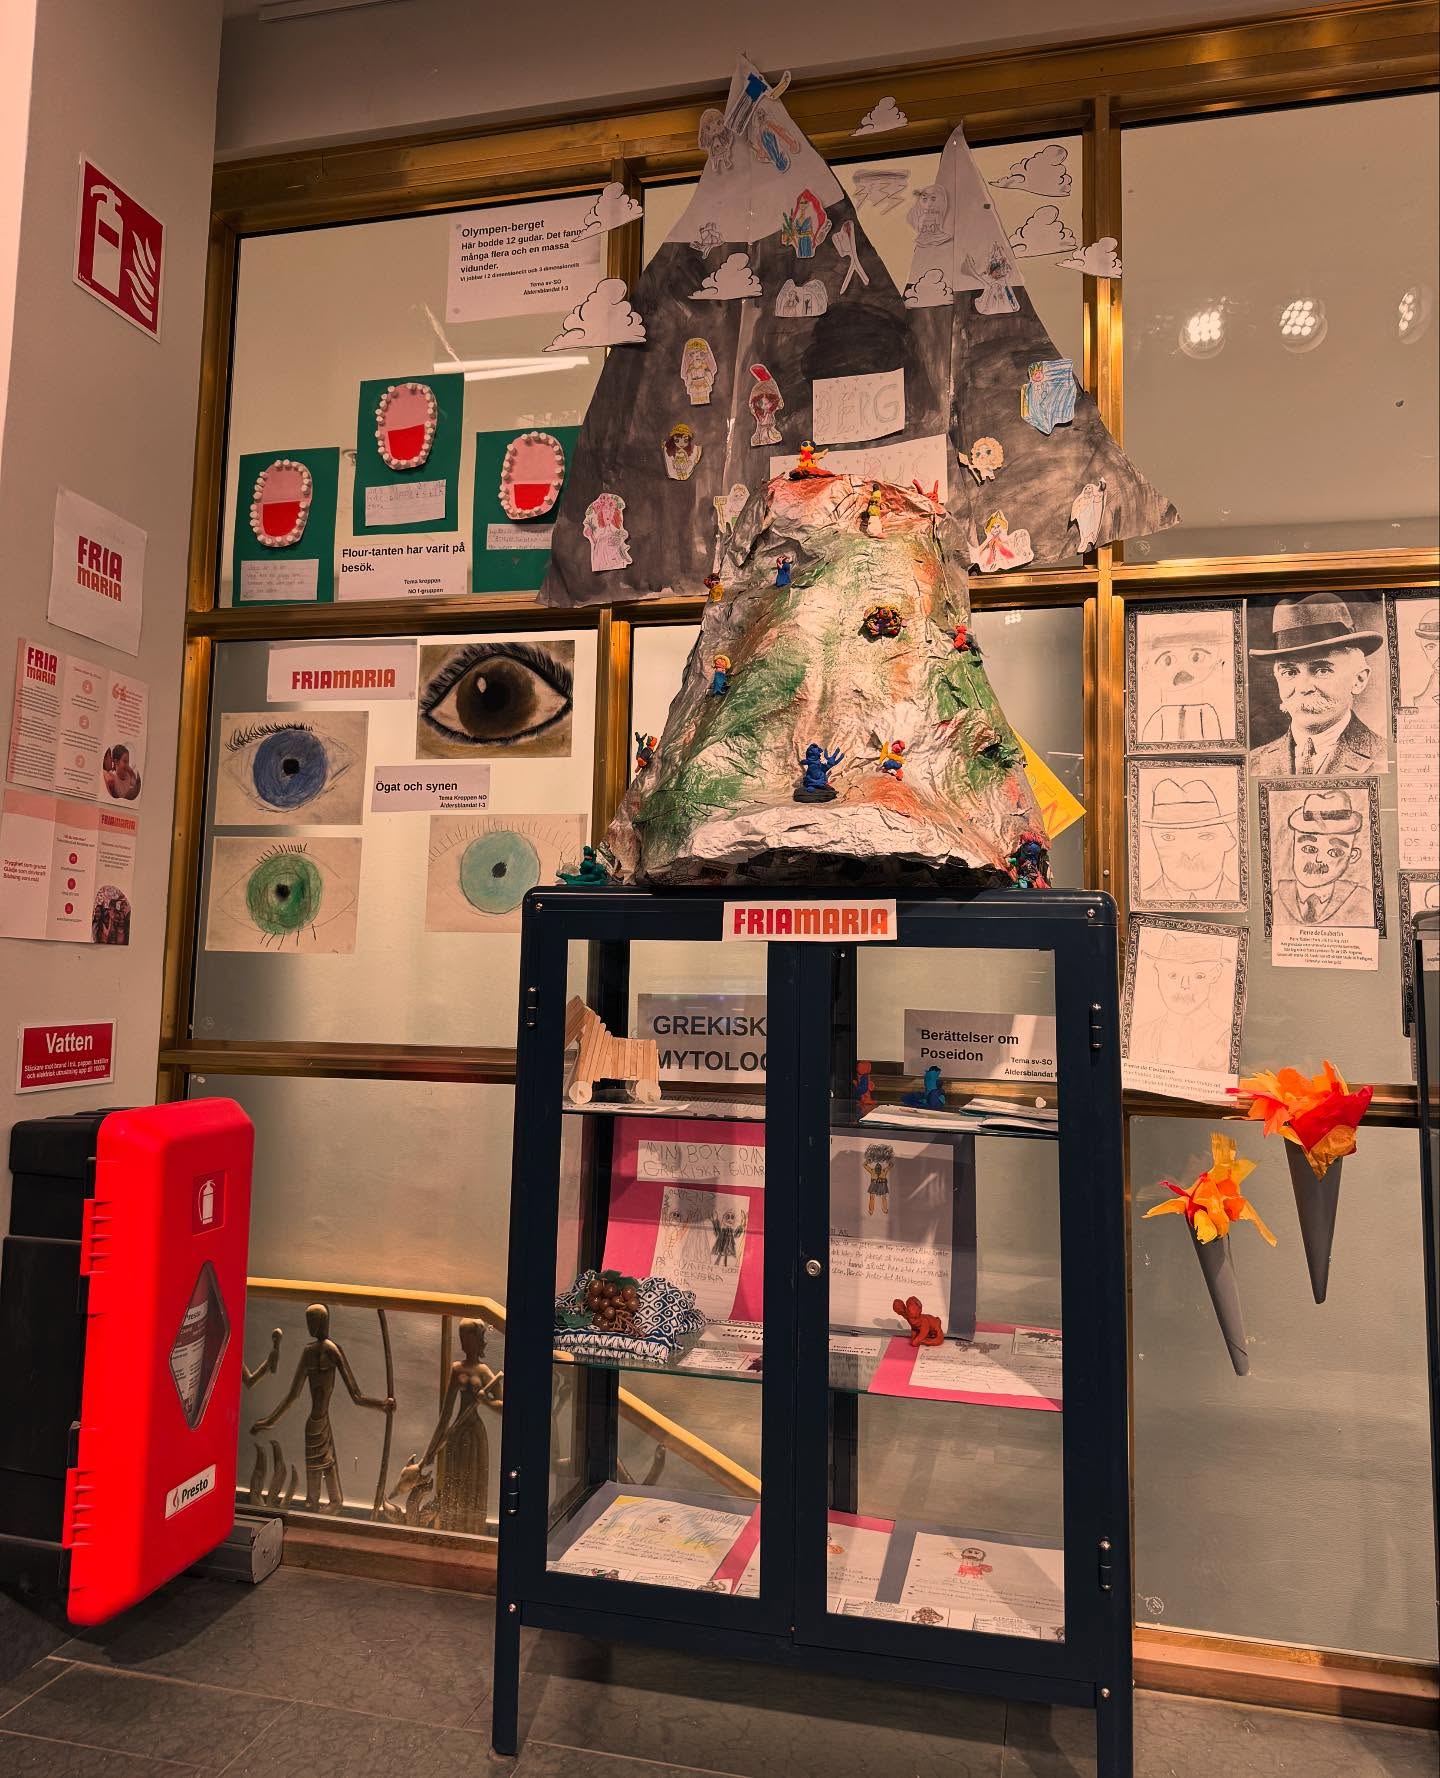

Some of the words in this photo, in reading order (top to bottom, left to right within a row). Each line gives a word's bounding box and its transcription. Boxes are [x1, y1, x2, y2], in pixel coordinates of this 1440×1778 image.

[462, 219, 544, 238] Olympen-berget
[462, 241, 476, 250] Här
[478, 238, 504, 249] bodde
[506, 237, 516, 245] 12
[518, 234, 544, 246] gudar.
[546, 231, 561, 240] Det
[563, 229, 582, 238] fann
[461, 251, 489, 262] många
[491, 249, 509, 258] flera
[511, 246, 527, 256] och
[529, 245, 540, 254] en
[542, 242, 569, 252] massa
[460, 263, 499, 273] vidunder.
[78, 535, 123, 582] FRIA
[342, 547, 403, 558] Flour-tanten
[406, 545, 422, 554] har
[426, 544, 450, 554] varit
[452, 541, 466, 555] på
[341, 562, 375, 573] besök.
[78, 565, 122, 602] MARIA
[27, 646, 58, 674] FRIA
[26, 665, 56, 686] MARIA
[291, 669, 396, 690] FRIAMARIA
[375, 780, 401, 793] Ögat
[403, 781, 423, 792] och
[425, 782, 458, 794] synen
[733, 908, 888, 935] FRIAMARIA
[653, 1015, 767, 1037] GREKISK
[45, 1032, 93, 1054] Vatten
[921, 1029, 994, 1044] Berättelser
[998, 1035, 1019, 1045] om
[921, 1047, 984, 1062] Poseidon
[1011, 1056, 1030, 1065] Tema
[1004, 1068, 1053, 1078] Åldersblandat
[181, 1478, 209, 1504] Presto
